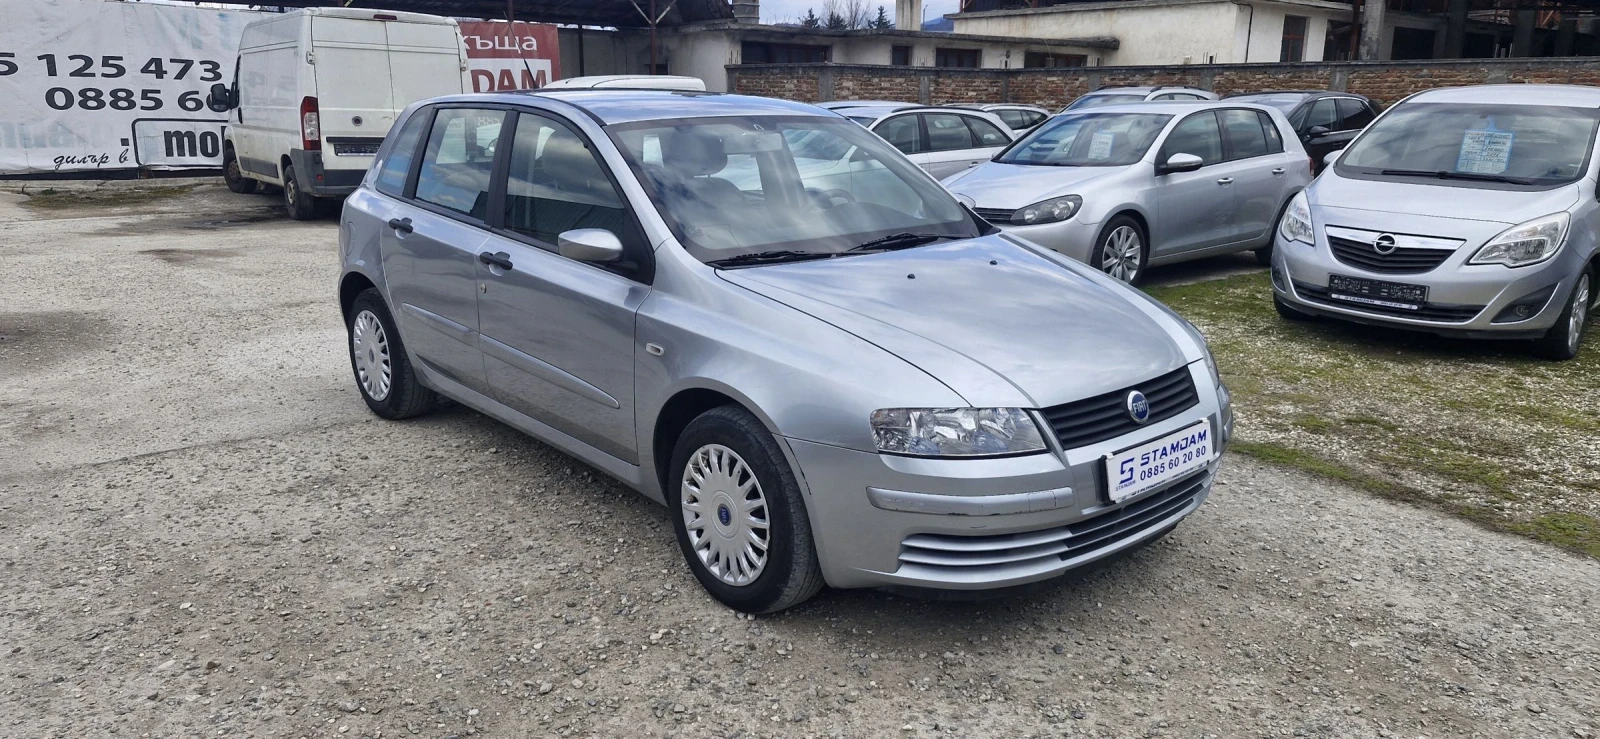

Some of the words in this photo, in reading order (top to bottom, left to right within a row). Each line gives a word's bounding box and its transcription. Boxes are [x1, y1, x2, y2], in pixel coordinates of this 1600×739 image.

[37, 54, 127, 78] 125
[140, 57, 223, 81] 473
[45, 87, 164, 111] 0885
[53, 153, 110, 170] дилър
[1133, 400, 1147, 413] FIAT
[1140, 464, 1166, 481] 0885
[1168, 456, 1180, 470] 60
[1182, 450, 1193, 464] 20
[1195, 445, 1206, 459] 80
